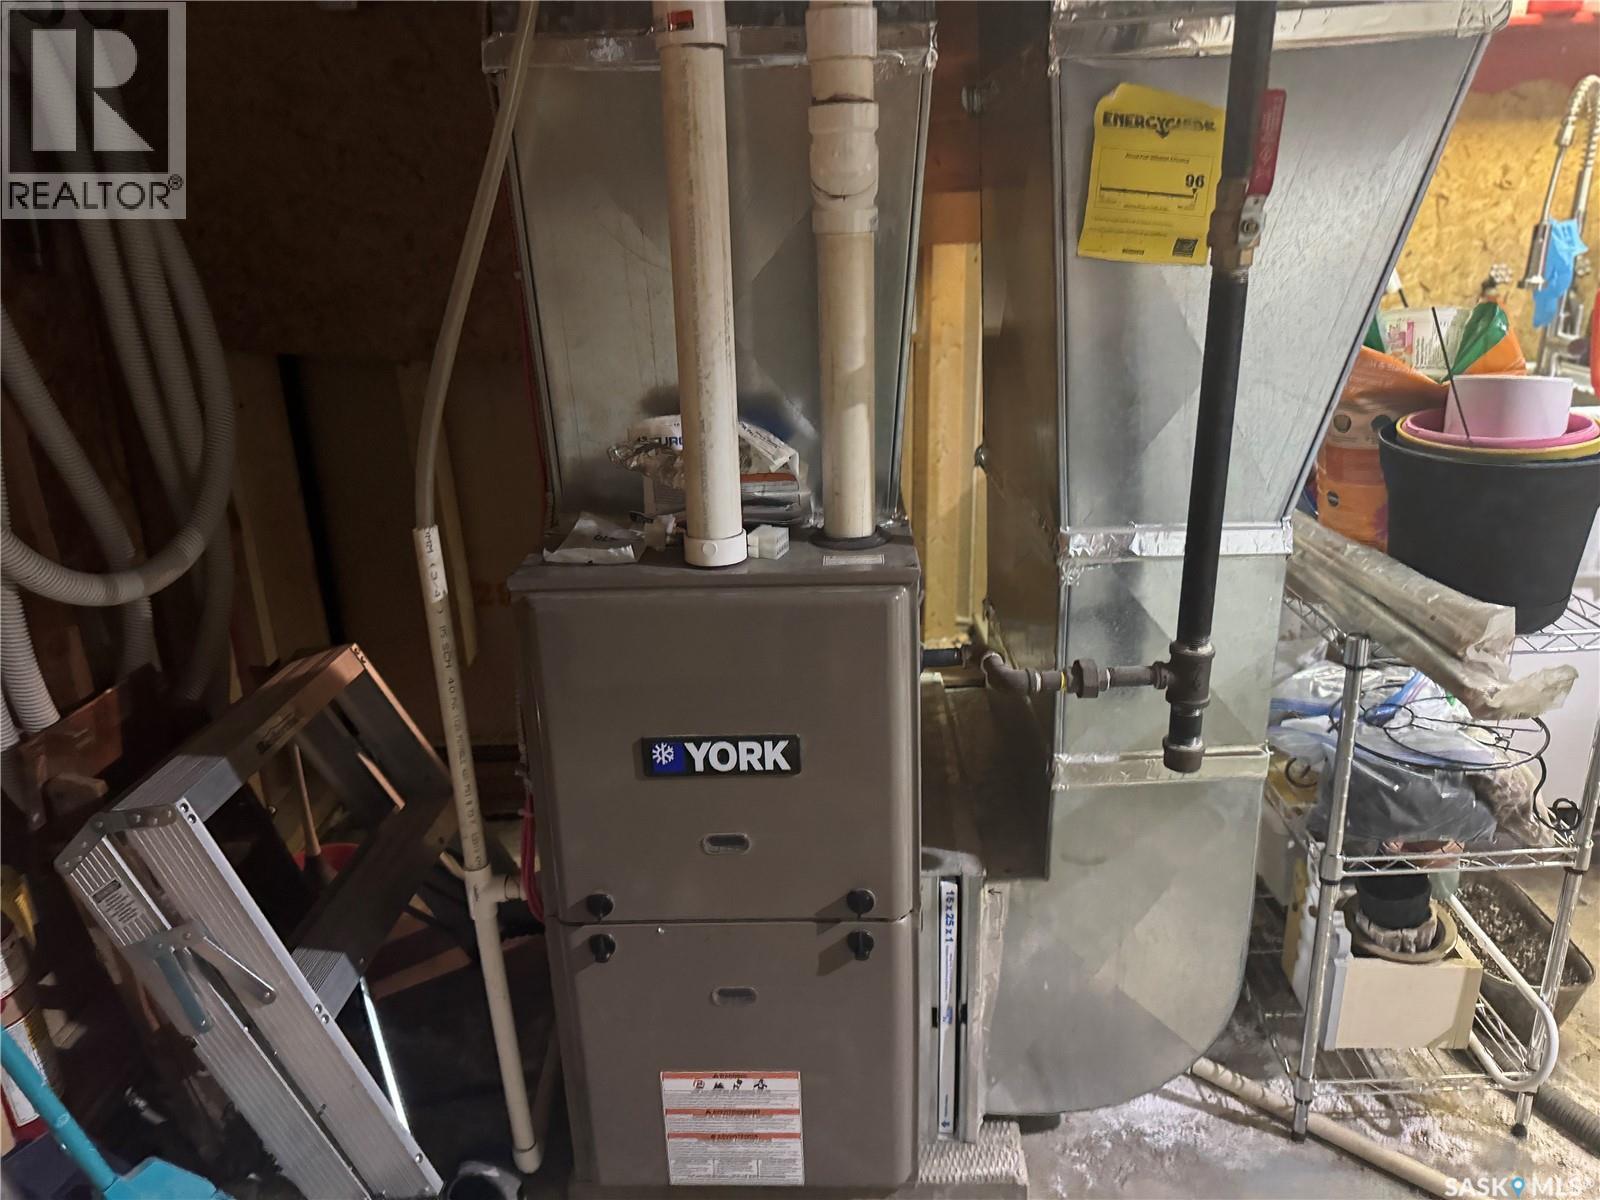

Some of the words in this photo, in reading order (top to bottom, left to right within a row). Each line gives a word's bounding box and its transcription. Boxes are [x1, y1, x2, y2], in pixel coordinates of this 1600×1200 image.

[447, 677, 455, 694] 40
[684, 740, 791, 772] YORK
[945, 913, 954, 926] 25
